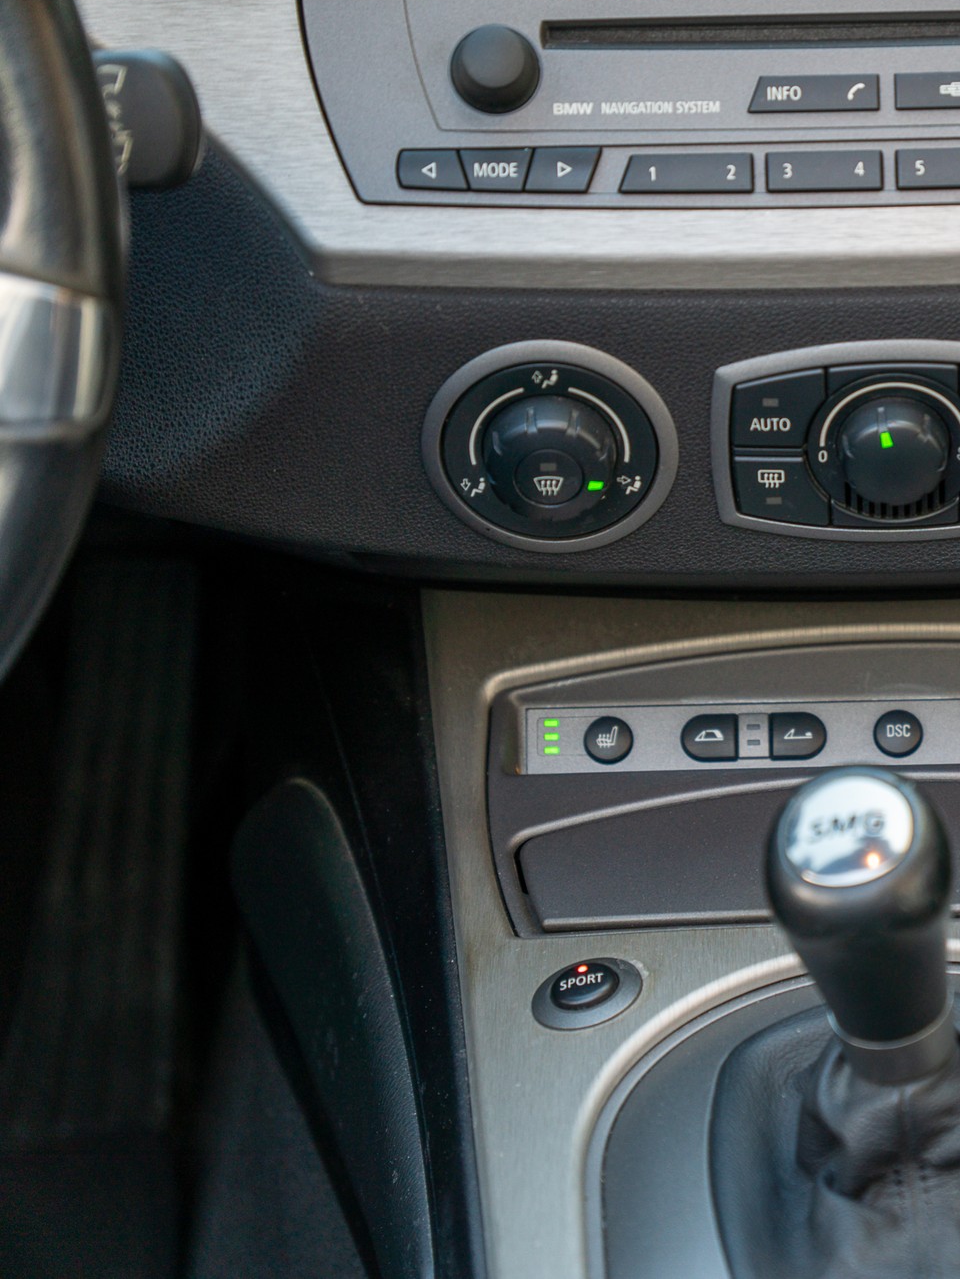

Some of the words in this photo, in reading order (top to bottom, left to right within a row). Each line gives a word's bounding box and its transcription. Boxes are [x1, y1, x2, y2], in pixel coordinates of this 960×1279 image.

[766, 85, 802, 101] INFO
[552, 100, 594, 116] BMW
[600, 101, 673, 115] NAVIGATION
[674, 99, 721, 114] SYSTEM
[473, 162, 519, 178] MODE
[648, 166, 657, 182] 1
[726, 164, 736, 181] 2
[782, 162, 793, 179] 3
[853, 161, 865, 177] 4
[914, 159, 926, 176] 5
[749, 417, 791, 432] AUTO
[886, 723, 911, 738] DSC
[559, 972, 604, 991] SPORT
